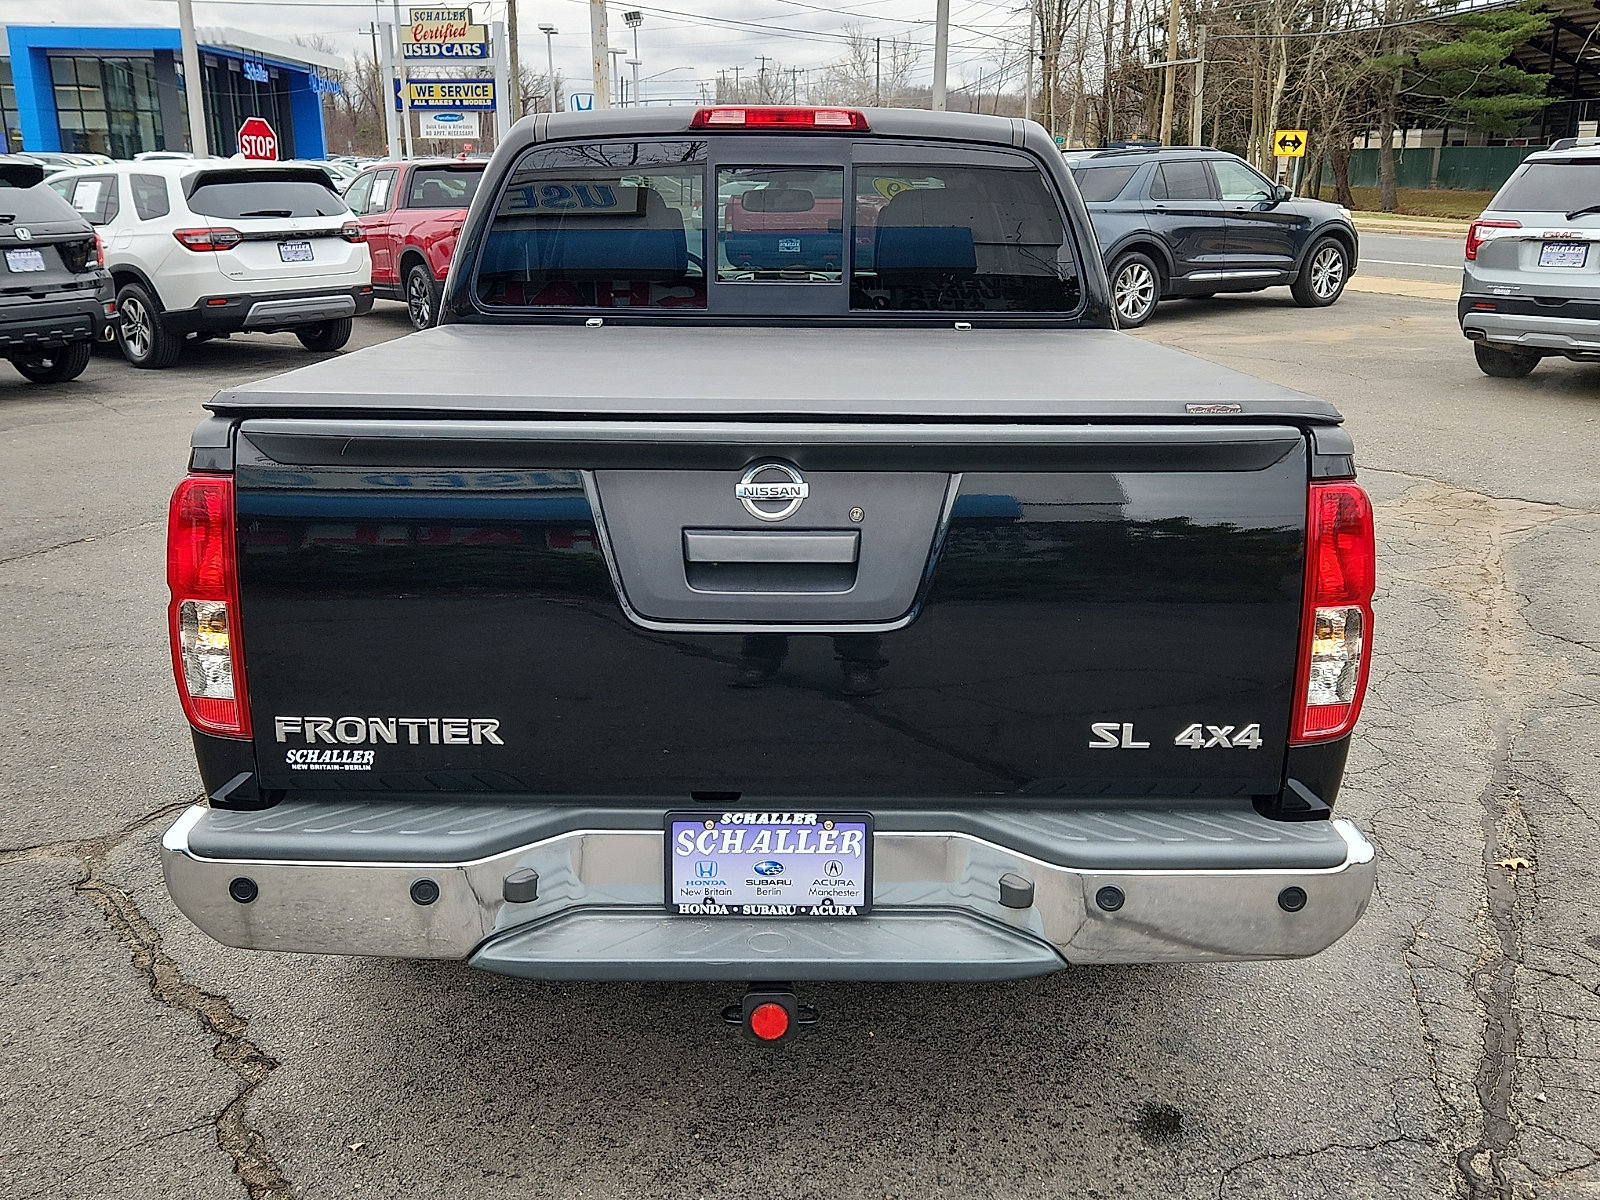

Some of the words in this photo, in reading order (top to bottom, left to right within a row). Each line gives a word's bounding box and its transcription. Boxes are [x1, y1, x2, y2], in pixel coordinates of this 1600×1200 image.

[414, 11, 466, 21] SCHALLER
[413, 22, 467, 44] Certified
[403, 44, 440, 56] USED
[441, 44, 482, 56] CARS
[415, 85, 434, 98] WE
[440, 85, 489, 98] SERVICE
[241, 134, 275, 157] STOP
[1542, 231, 1584, 239] GMC
[744, 487, 801, 496] NISSAN
[275, 716, 504, 745] FRONTIER
[1089, 722, 1150, 749] SL
[286, 749, 375, 765] SCHALLER
[720, 813, 818, 826] SCHALLER
[675, 829, 864, 858] SCHALLER
[680, 888, 702, 896] New
[704, 887, 732, 896] Britain
[756, 887, 782, 896] Berlin
[808, 888, 859, 897] Manchester
[678, 904, 730, 915] HONDA
[742, 904, 797, 916] SUBARU
[809, 904, 858, 916] ACURA
